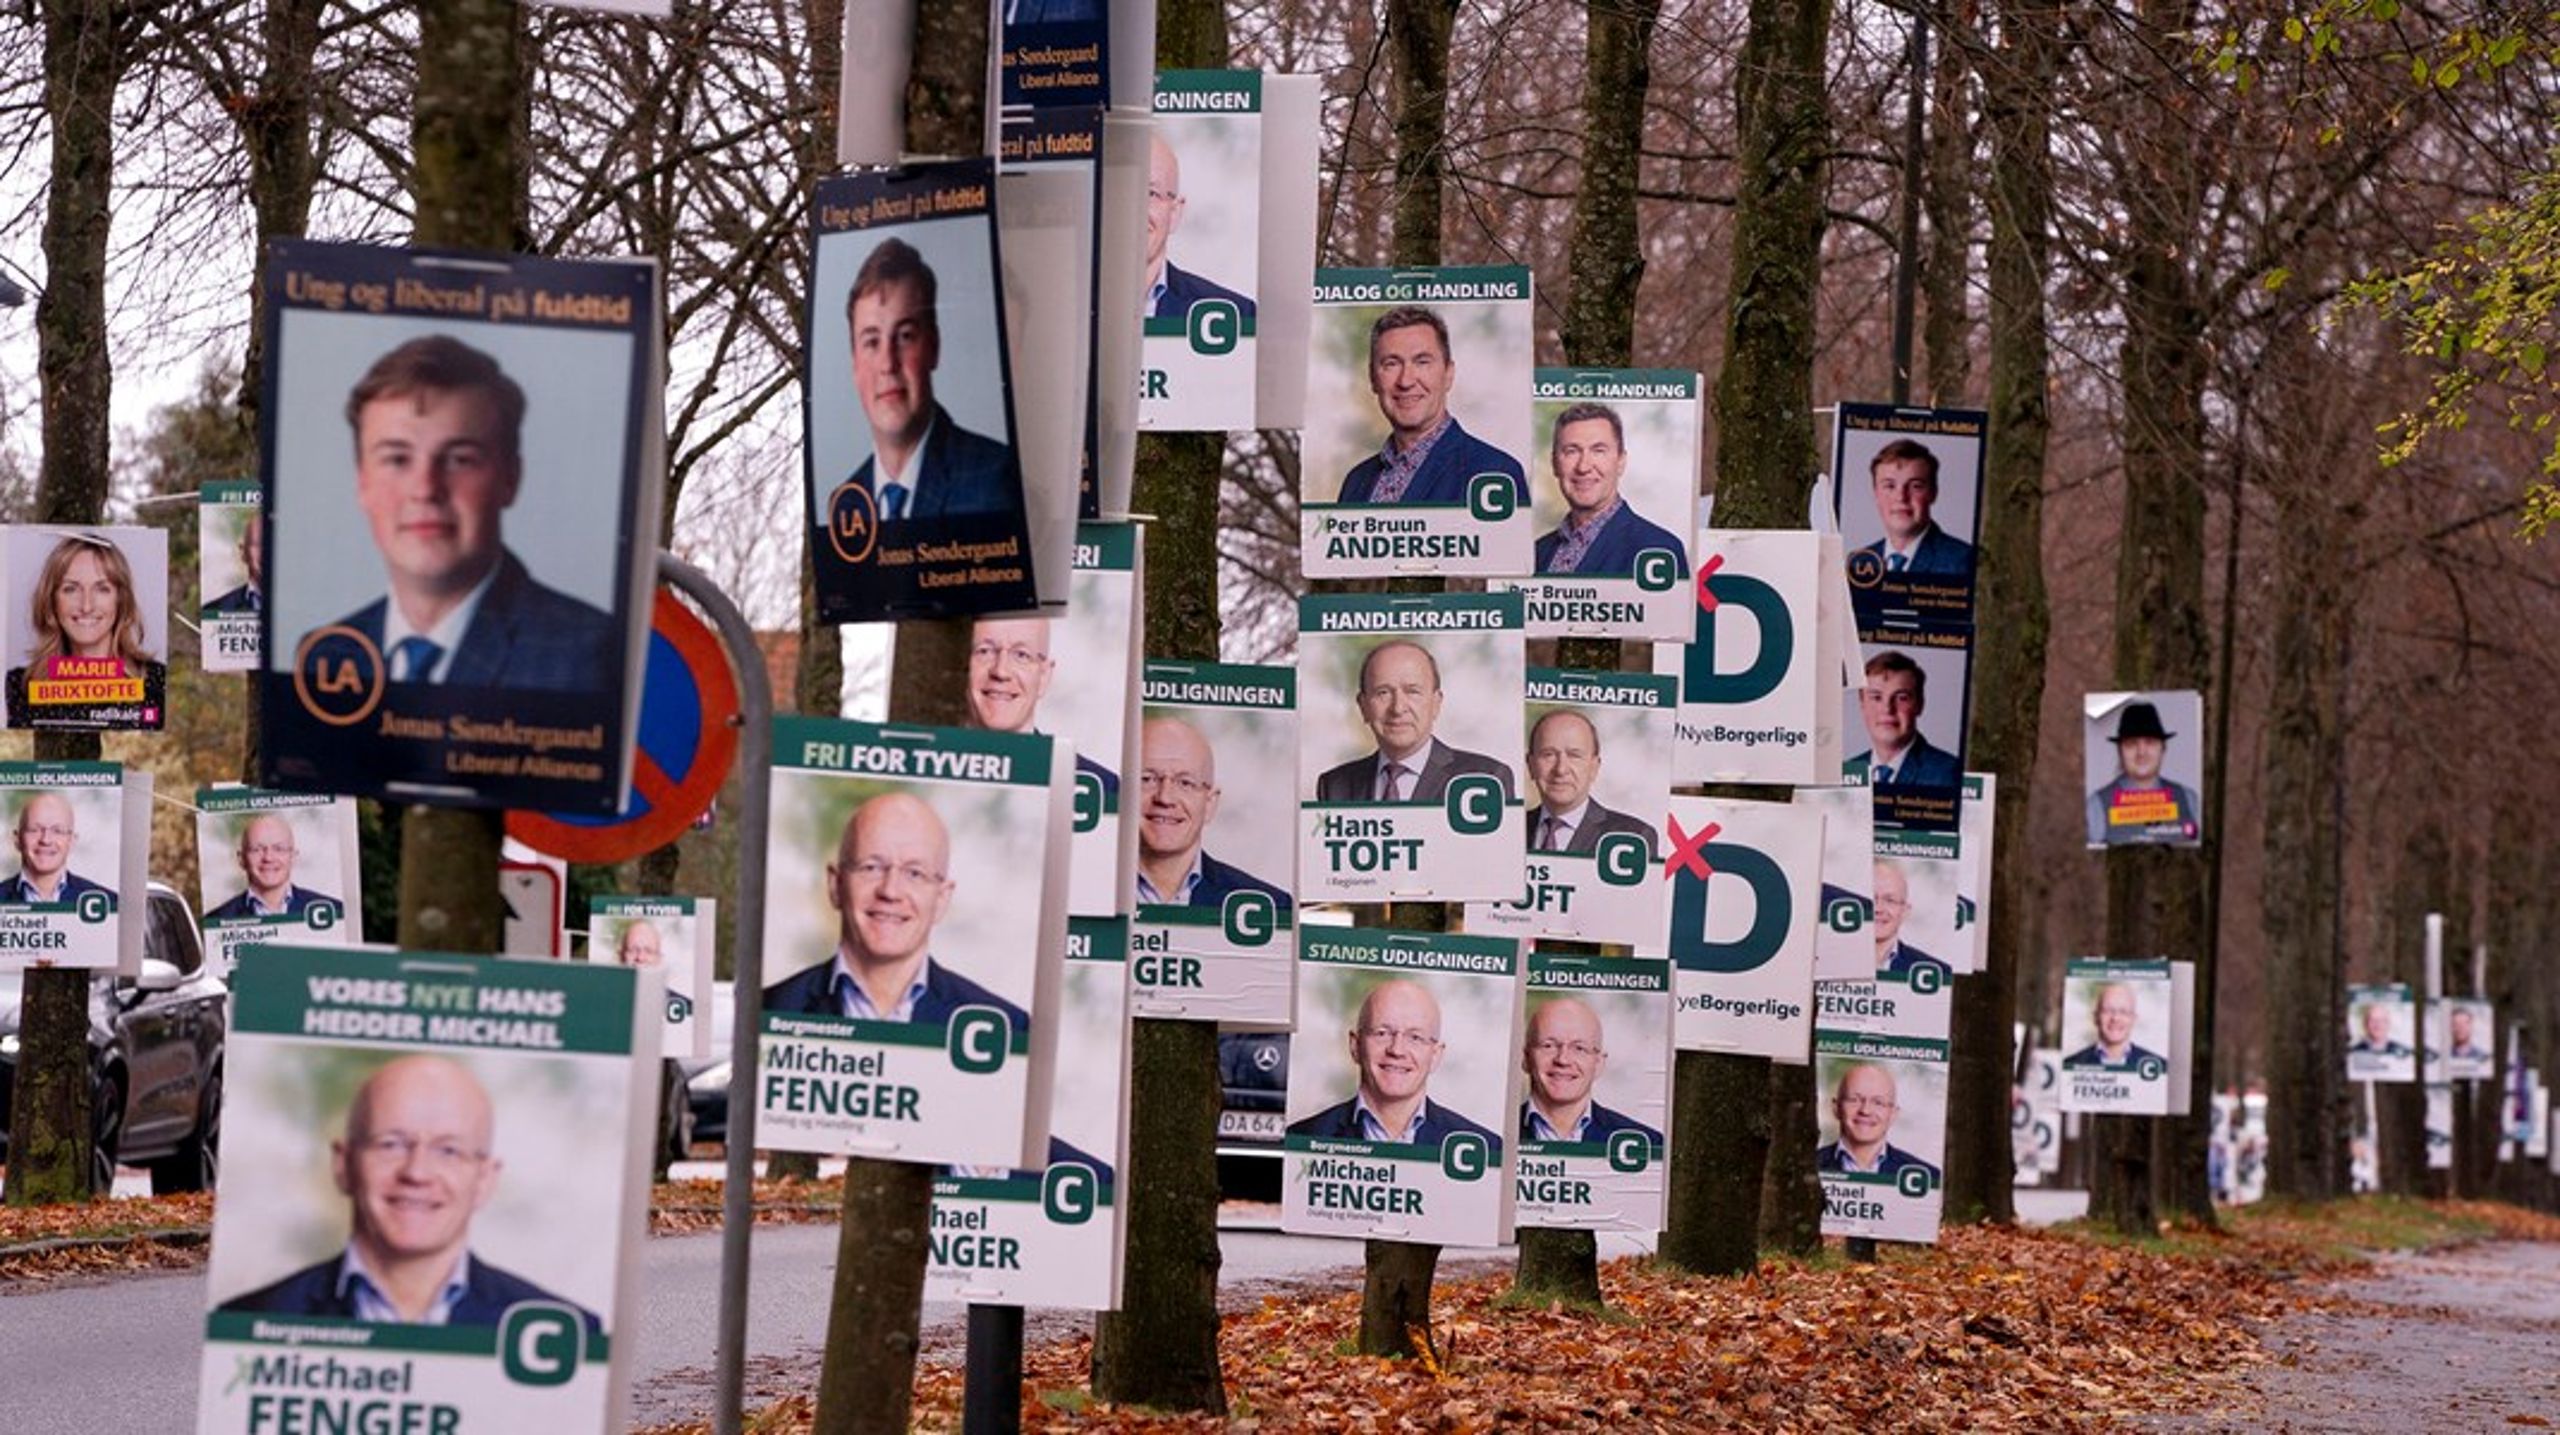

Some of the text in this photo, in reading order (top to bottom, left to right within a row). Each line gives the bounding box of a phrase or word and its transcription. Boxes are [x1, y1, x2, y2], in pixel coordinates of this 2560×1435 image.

[1020, 43, 1098, 67] Søndergaard
[1019, 72, 1099, 89] Liberal Alliance
[1026, 137, 1045, 163] på
[1047, 132, 1094, 154] fuldtid
[821, 185, 986, 230] Ung og liberal på fuldtid
[285, 271, 633, 324] Ung og liberal på fuldtid
[1313, 282, 1519, 300] DIALOG OG HANDLING
[1199, 311, 1226, 346] C
[1569, 383, 1594, 397] OG
[1597, 384, 1686, 398] HANDLING
[1479, 484, 1504, 513] C
[841, 510, 866, 537] LA
[1326, 516, 1427, 534] Per Bruun
[878, 536, 1019, 566] Jonas Søndergaard
[1326, 534, 1481, 559] ANDERSEN
[919, 567, 1024, 588] Liberal Alliance
[1645, 558, 1667, 584] C
[1543, 585, 1598, 600] Bruun
[1321, 609, 1504, 631] HANDLEKRAFTIG
[1684, 572, 1795, 704] D
[56, 660, 118, 677] MARIE
[316, 657, 363, 693] LA
[37, 682, 138, 700] BRIXTOFTE
[1143, 680, 1286, 706] UDLIGNINGEN
[90, 707, 155, 722] radikale B
[379, 711, 602, 751] Jonas Søndergaard
[446, 752, 602, 781] Liberal Alliance
[803, 741, 1012, 781] FRI FOR TYVERI
[33, 772, 117, 785] UDLIGNINGEN
[202, 793, 331, 810] STANDS UDLIGNINGEN
[1459, 786, 1489, 824] C
[1324, 814, 1394, 838] Hans
[1324, 838, 1425, 872] TOFT
[1607, 843, 1635, 876] C
[1332, 877, 1377, 889] Regionen
[84, 898, 102, 918] C
[312, 906, 328, 925] C
[1236, 902, 1262, 937] C
[1836, 906, 1855, 927] C
[222, 927, 279, 944] Michael
[1308, 942, 1508, 973] STANDS UDLIGNINGEN
[1545, 970, 1661, 989] UDLIGNINGEN
[1916, 969, 1934, 989] C
[307, 976, 567, 1016] VORES NYE HANS
[669, 1004, 683, 1020] C
[304, 1008, 564, 1049] HEDDER MICHAEL
[769, 1015, 857, 1040] Borgmester
[960, 1019, 995, 1063] C
[1853, 1043, 1943, 1061] UDLIGNINGEN
[765, 1043, 885, 1078] Michael
[2142, 1062, 2157, 1078] C
[763, 1075, 922, 1122] FENGER
[2073, 1086, 2130, 1099] FENGER
[763, 1111, 865, 1134] Dialog og Handling
[1223, 1113, 1248, 1132] DA
[1310, 1139, 1374, 1156] Borgmester
[1454, 1143, 1476, 1173] C
[1618, 1139, 1639, 1166] C
[1309, 1158, 1397, 1184] Michael
[1905, 1171, 1923, 1193] C
[1054, 1175, 1083, 1214] C
[1307, 1182, 1425, 1217] FENGER
[252, 1319, 374, 1346] Borgmester
[518, 1319, 564, 1374] C
[249, 1354, 414, 1394] Michael
[247, 1394, 462, 1435] FENGER
